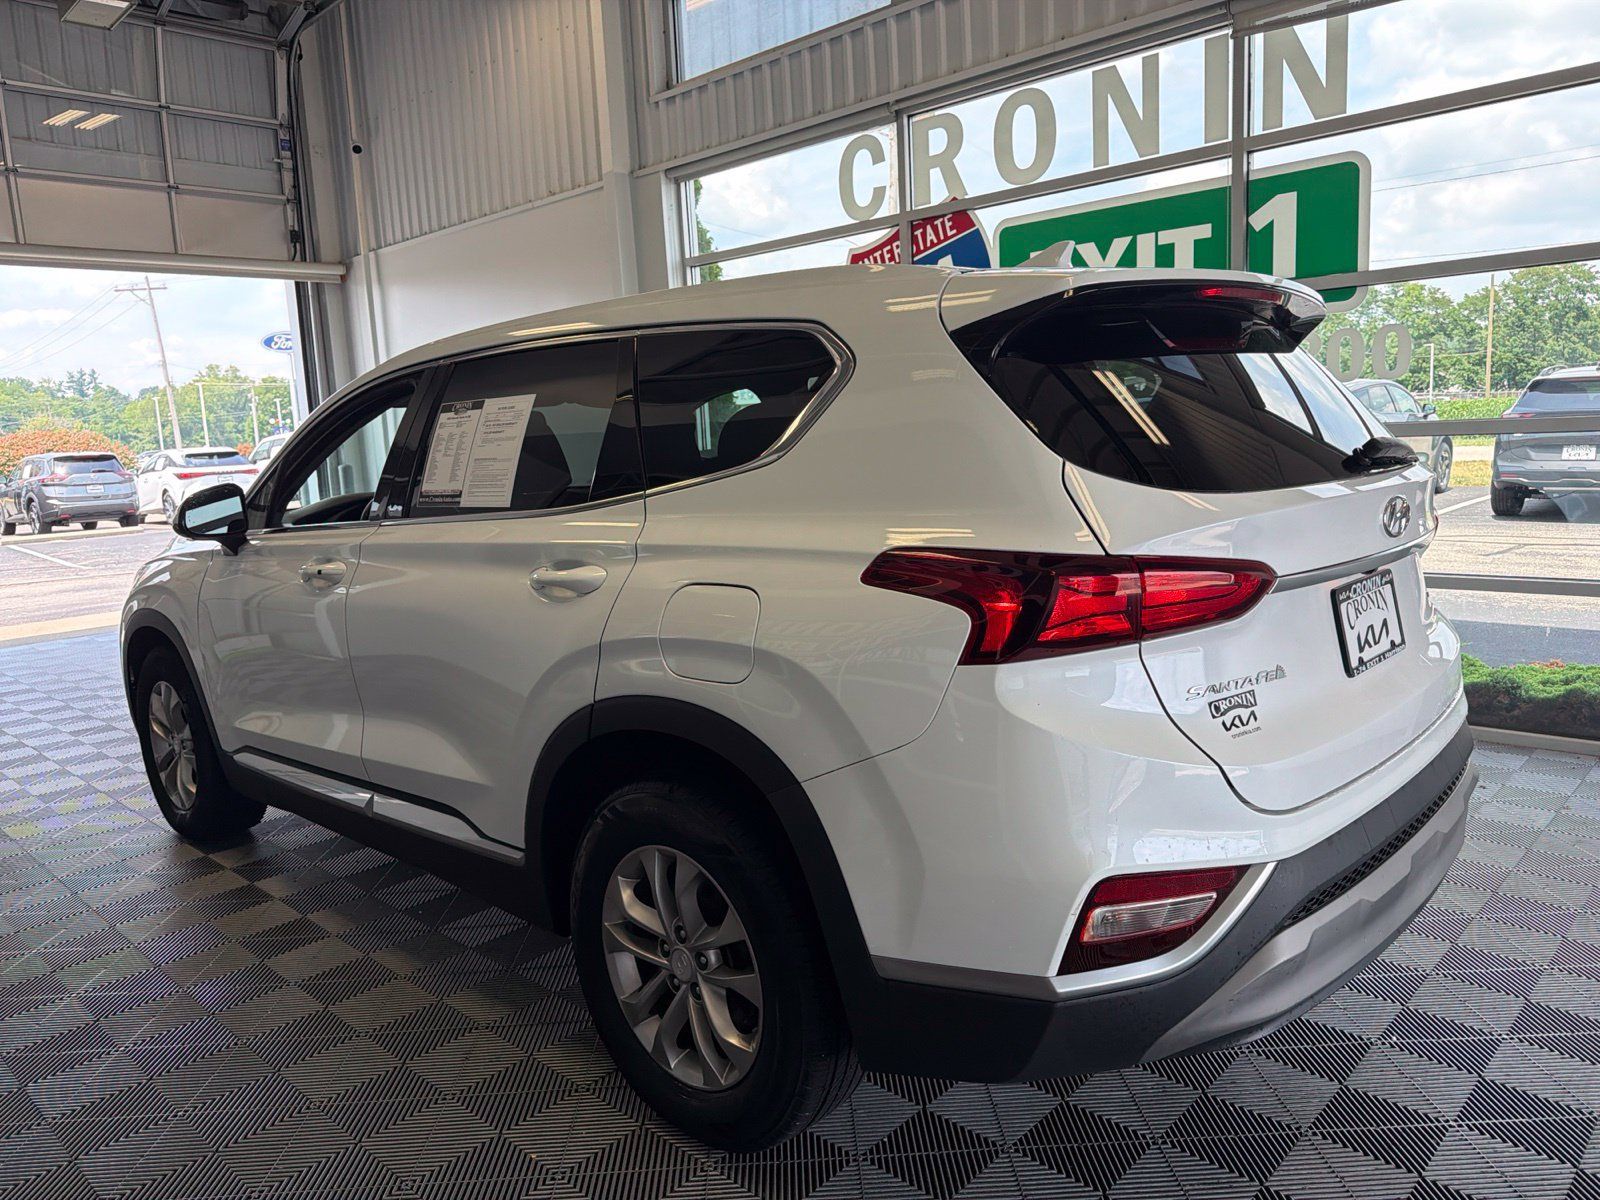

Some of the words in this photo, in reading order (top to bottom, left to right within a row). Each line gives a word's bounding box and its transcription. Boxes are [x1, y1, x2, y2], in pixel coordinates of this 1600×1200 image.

[838, 14, 1349, 220] CRONIN
[1248, 191, 1298, 278] 1
[1350, 575, 1382, 598] CRONIN
[1346, 587, 1390, 630] CRONIN
[1357, 618, 1389, 654] KIA
[1210, 691, 1256, 717] CRONIN
[1221, 709, 1258, 732] KIA
